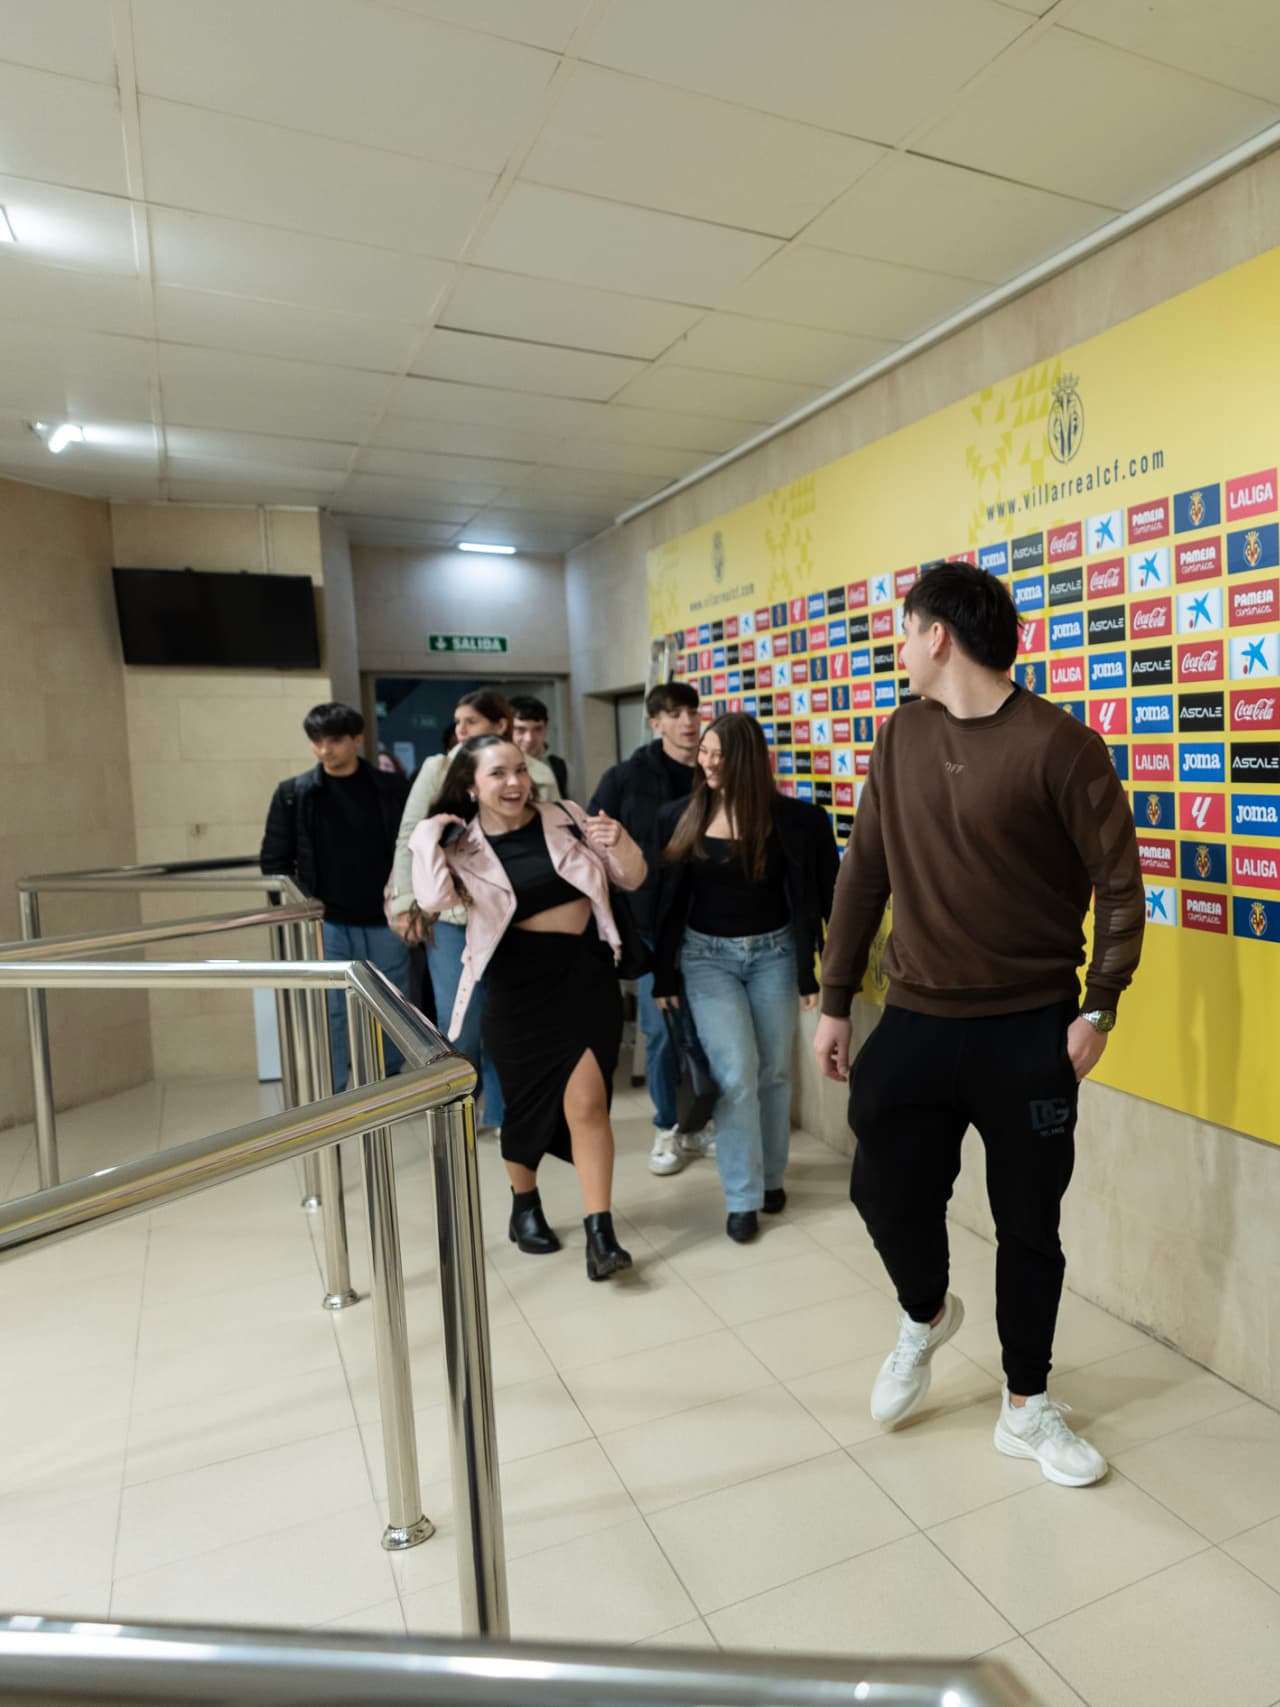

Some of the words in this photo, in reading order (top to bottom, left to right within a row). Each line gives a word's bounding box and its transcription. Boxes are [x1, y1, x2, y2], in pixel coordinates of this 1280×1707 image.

[986, 450, 1164, 520] www.villarrealcf.com
[1230, 483, 1273, 508] LALIGA
[453, 637, 501, 649] SALIDA
[1132, 660, 1171, 673] ASCALE
[1180, 707, 1222, 718] ASCALE
[1234, 699, 1274, 721] Coca-Cola
[1233, 756, 1279, 768] ASCALE
[1236, 858, 1277, 878] LALIGA
